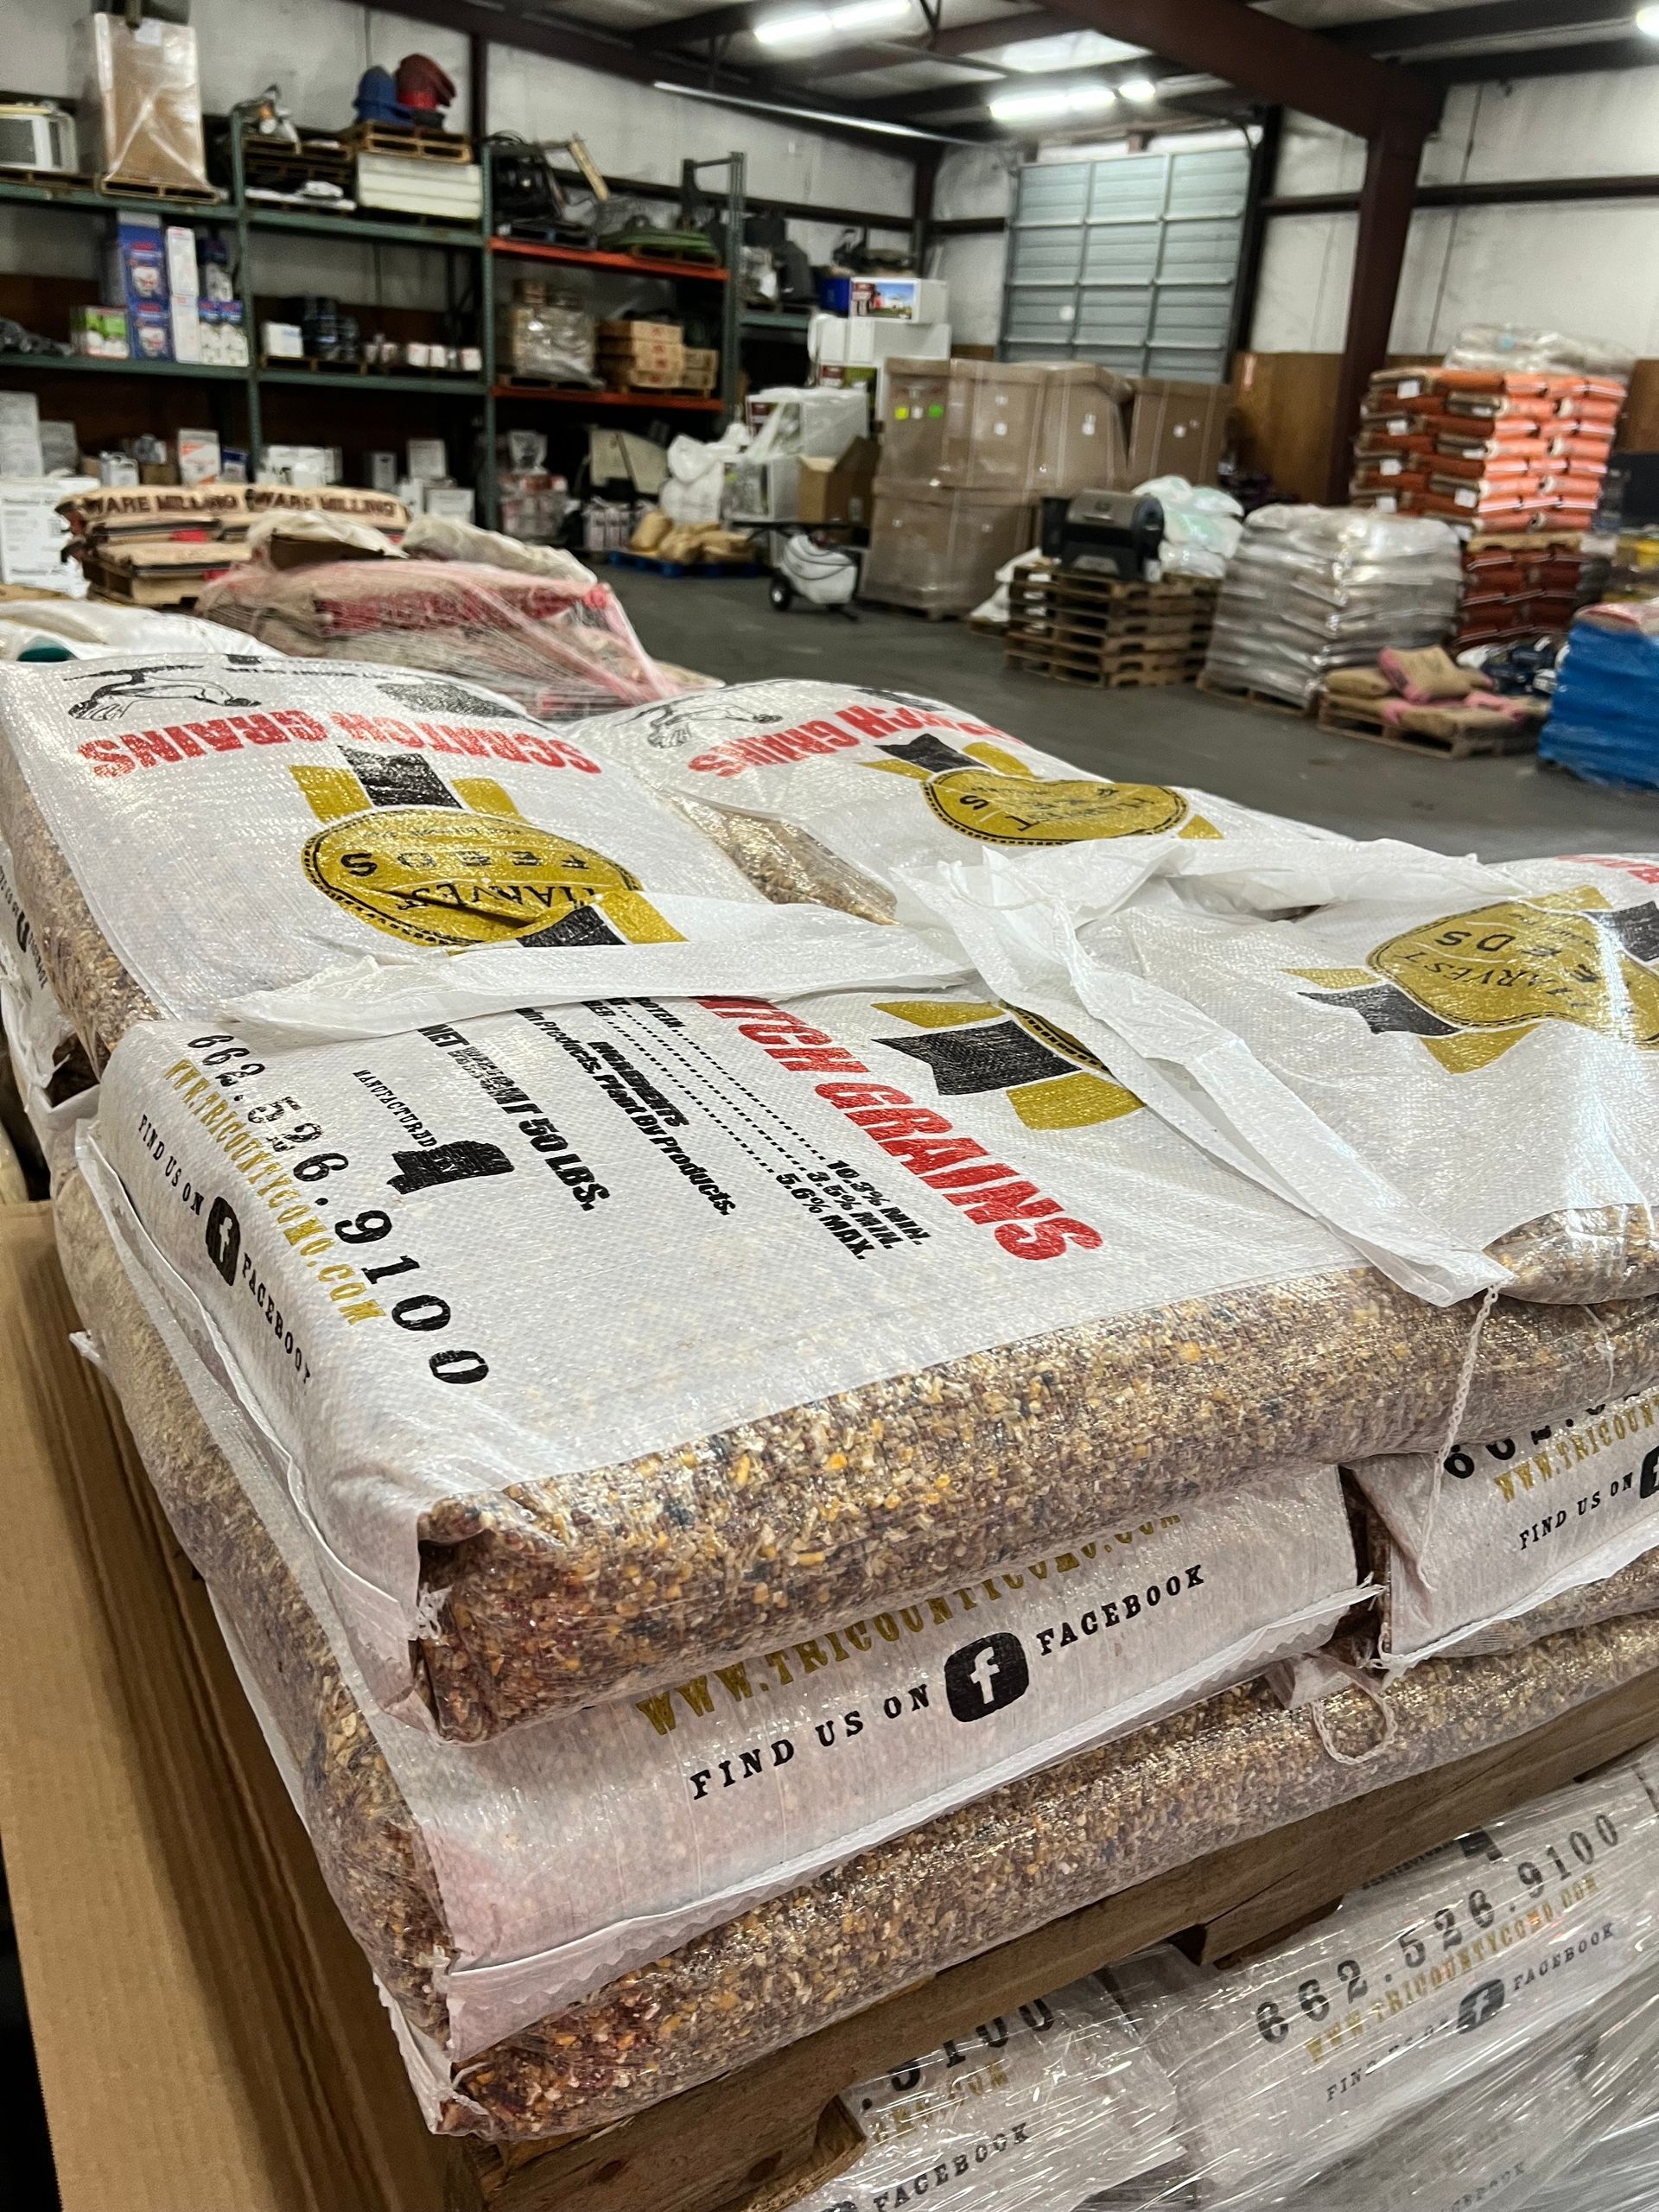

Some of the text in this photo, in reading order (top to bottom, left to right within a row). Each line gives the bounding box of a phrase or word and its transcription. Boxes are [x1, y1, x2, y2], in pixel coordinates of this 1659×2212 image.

[82, 496, 150, 515] WARE
[76, 709, 602, 779] SCRATCH GRAINS
[353, 1069, 438, 1147] MANUFACTURED
[416, 1023, 470, 1047] NET
[518, 1117, 568, 1153] 50
[544, 1153, 611, 1211] LBS.
[592, 1074, 648, 1115] Plant
[630, 1114, 668, 1135] By
[649, 1136, 736, 1216] Products.
[138, 1114, 163, 1160] FIND
[167, 1153, 181, 1186] US
[181, 1184, 206, 1217] ON
[163, 1058, 387, 1326] WWW.TRICOUNTYCOMO.COM
[187, 1033, 489, 1385] 662.526.9100
[806, 1171, 861, 1211] 3.5%
[849, 1211, 904, 1249] MIN.
[813, 1082, 1103, 1261] GRAINS
[827, 1160, 890, 1206] 10.3%
[878, 1206, 931, 1245] MIN.
[775, 1173, 831, 1213] 5.6%
[818, 1214, 875, 1260] MAX.
[1519, 1471, 1633, 1551] FIND US ON
[690, 1738, 795, 1801] FIND
[814, 1709, 866, 1748] US
[882, 1682, 931, 1720] ON
[1035, 1564, 1205, 1656] FACEBOOK
[1255, 1813, 1620, 2045] 662.526.9100
[1511, 1920, 1615, 1991] FACEBOOK
[872, 2121, 1031, 2212] FACEBOOK
